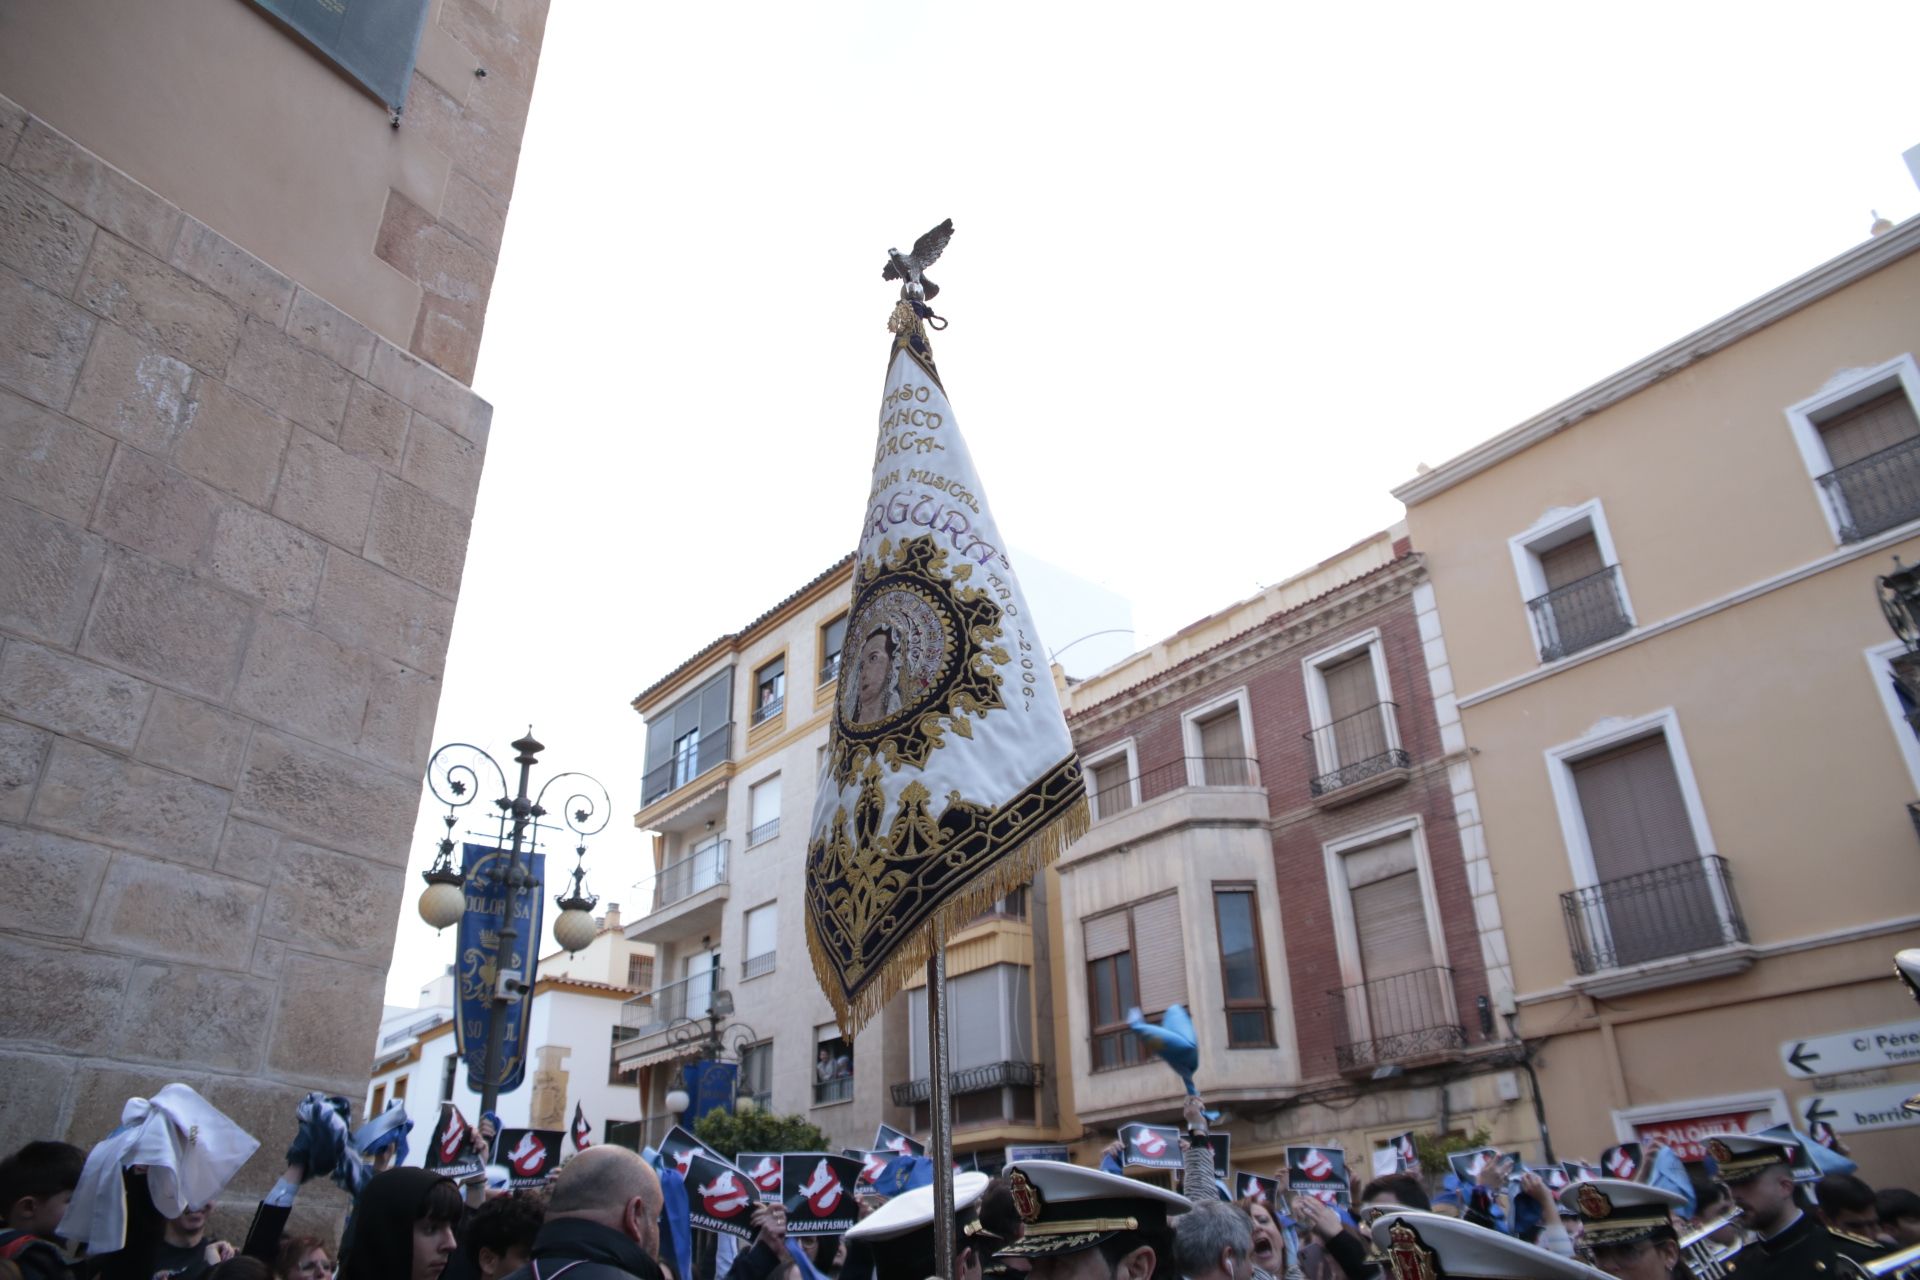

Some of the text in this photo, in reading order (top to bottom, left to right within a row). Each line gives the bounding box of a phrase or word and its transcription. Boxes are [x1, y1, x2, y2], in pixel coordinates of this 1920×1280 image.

[885, 383, 930, 409] ASO
[882, 408, 943, 436] ANCO
[906, 468, 980, 514] MUSICAL
[466, 895, 530, 919] DOLORSA
[1875, 1031, 1920, 1049] Pére
[1854, 1107, 1913, 1125] barrio
[786, 1220, 854, 1232] CAZAFANTASMAS
